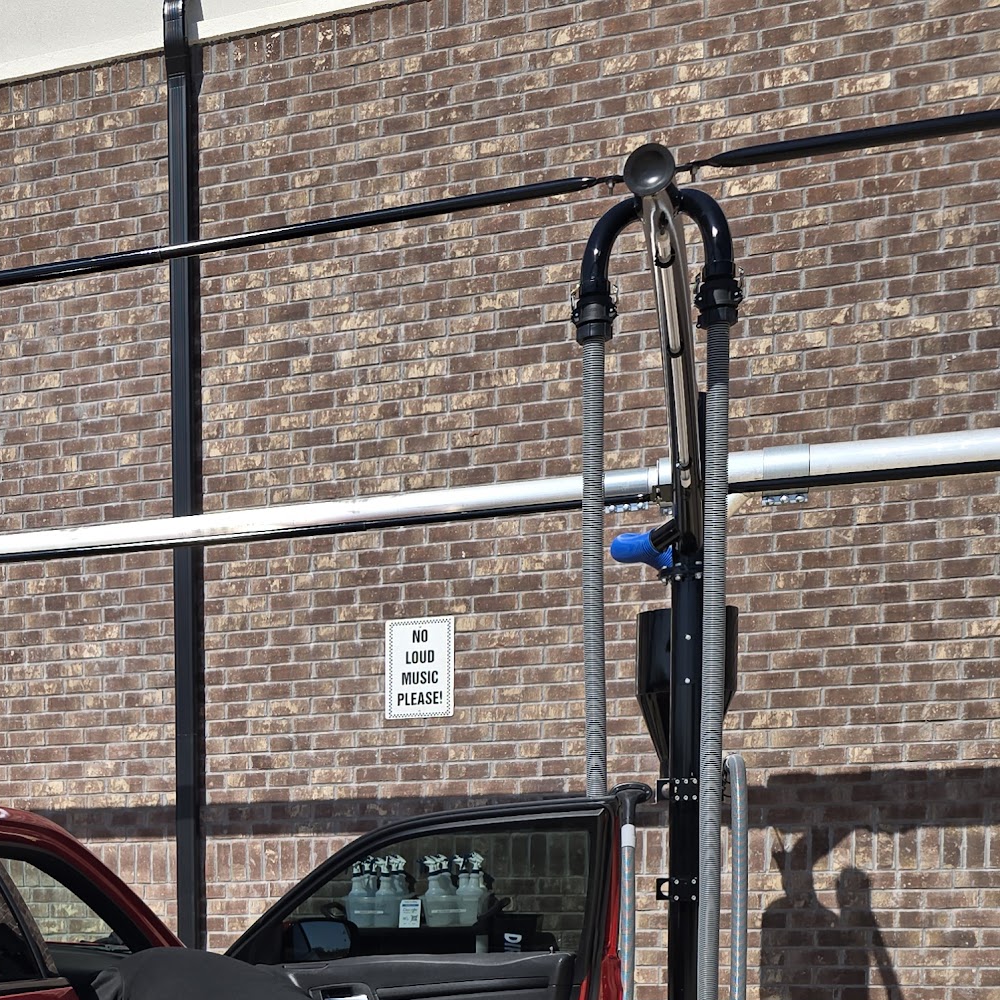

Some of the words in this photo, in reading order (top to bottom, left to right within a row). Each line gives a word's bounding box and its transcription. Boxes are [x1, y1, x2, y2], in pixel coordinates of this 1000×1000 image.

[412, 629, 428, 643] NO
[405, 650, 435, 664] LOUD
[401, 670, 439, 685] MUSIC
[397, 691, 443, 706] PLEASE!
